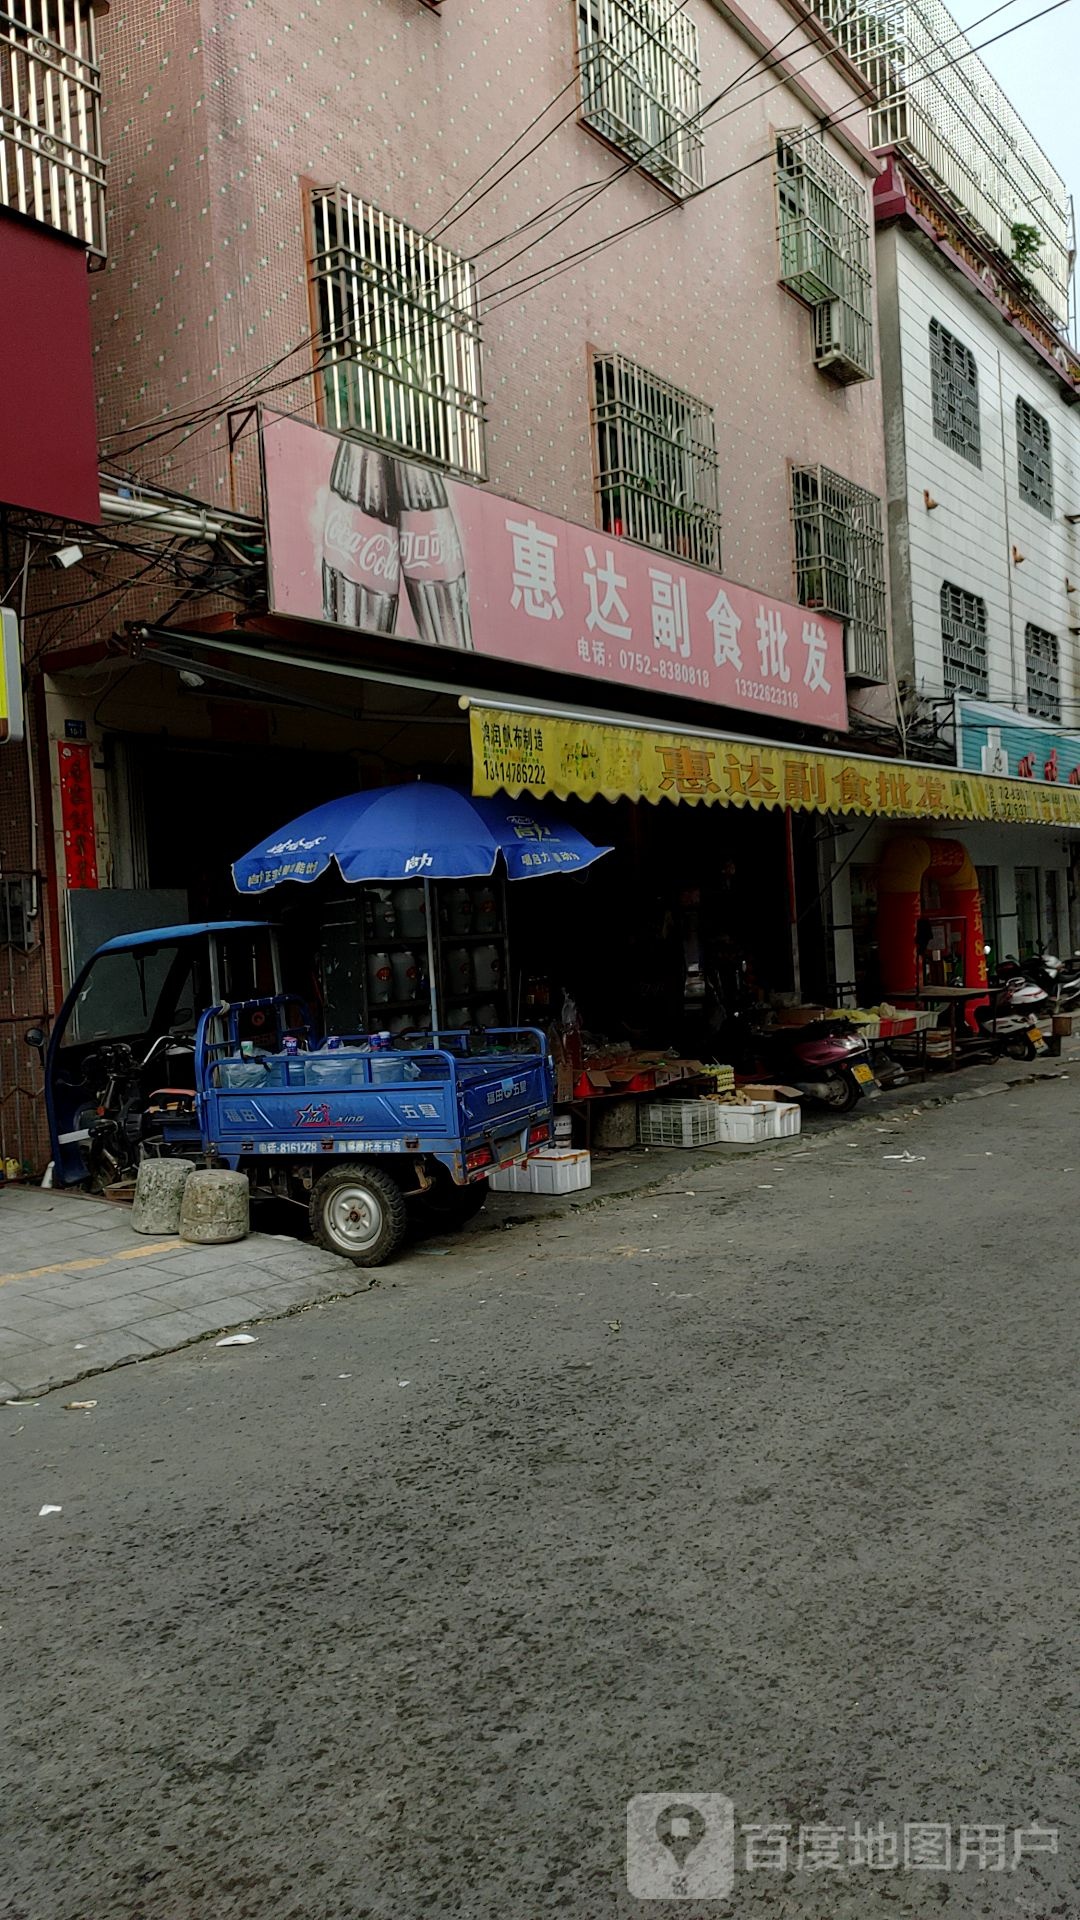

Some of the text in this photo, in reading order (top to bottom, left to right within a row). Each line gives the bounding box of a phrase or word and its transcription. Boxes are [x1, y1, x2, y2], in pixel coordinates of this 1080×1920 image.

[505, 517, 832, 695] 惠达副食批发
[654, 745, 949, 810] 惠达副食批发
